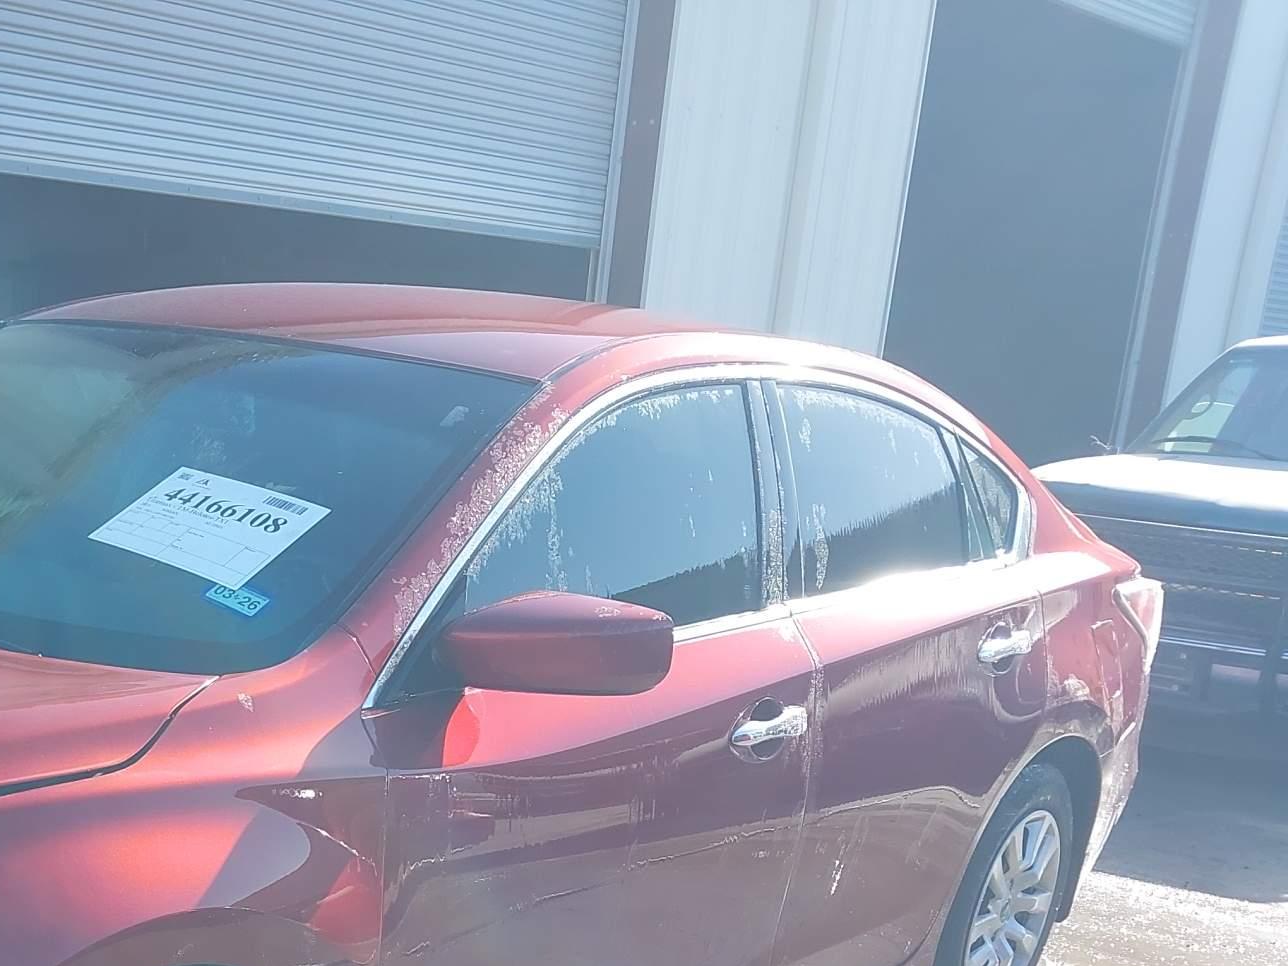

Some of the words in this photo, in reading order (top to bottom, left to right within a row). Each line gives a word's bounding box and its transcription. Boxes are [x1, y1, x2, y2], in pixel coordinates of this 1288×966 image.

[164, 488, 288, 533] 44166108
[214, 585, 236, 599] 03
[237, 596, 261, 610] 26
